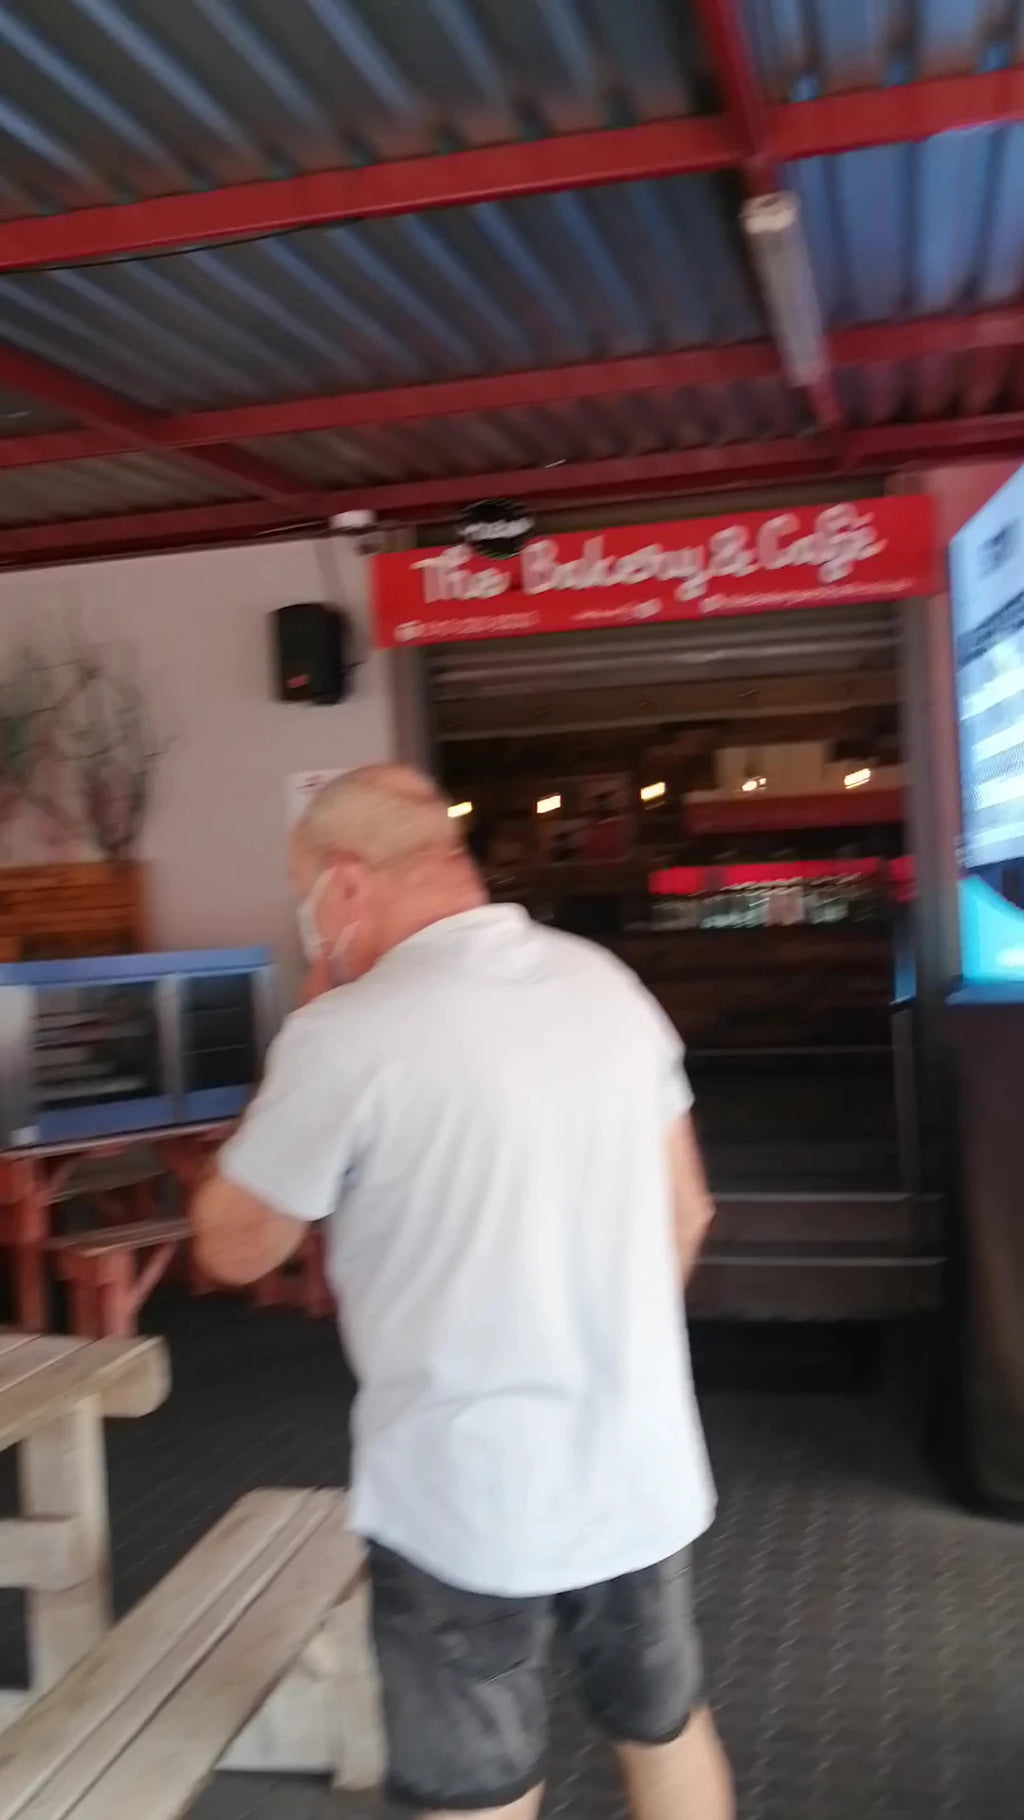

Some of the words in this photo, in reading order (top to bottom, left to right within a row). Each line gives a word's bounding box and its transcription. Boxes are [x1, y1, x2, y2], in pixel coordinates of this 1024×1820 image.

[410, 543, 511, 603] The
[520, 535, 706, 602] Bakery
[709, 524, 758, 577] &
